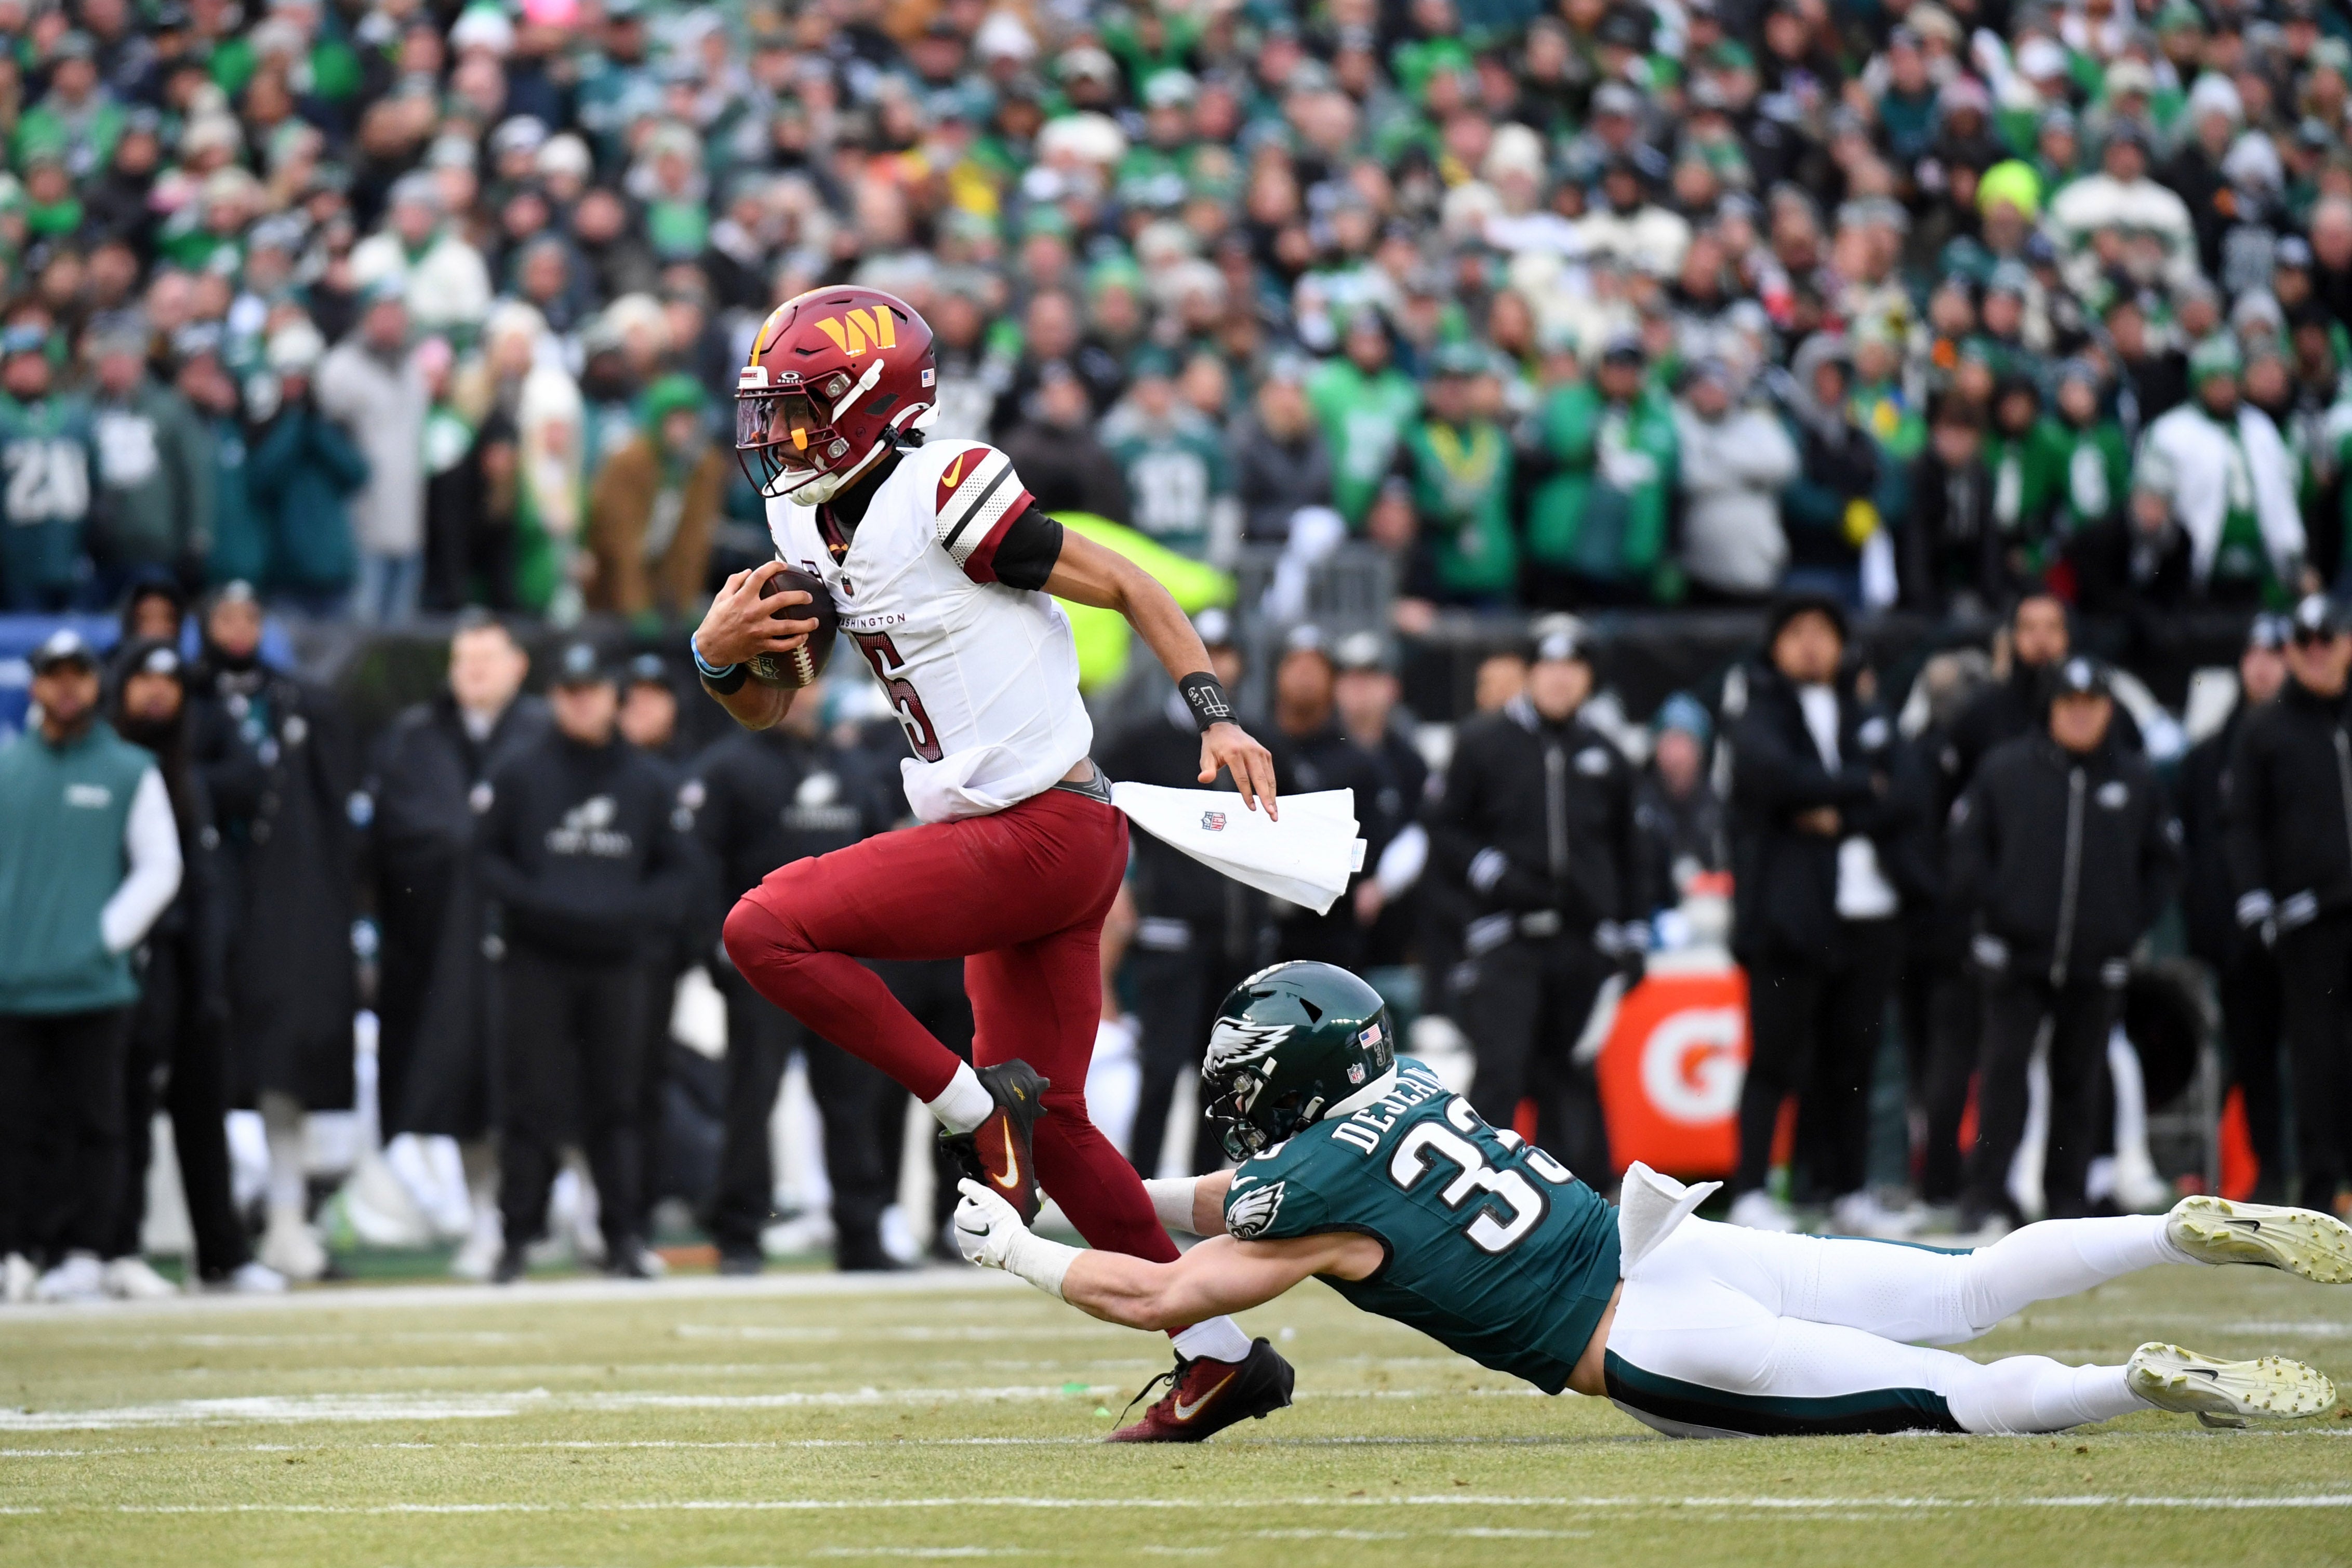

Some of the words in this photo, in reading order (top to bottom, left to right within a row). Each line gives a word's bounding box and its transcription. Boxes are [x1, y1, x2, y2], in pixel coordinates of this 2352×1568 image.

[814, 305, 896, 358] W
[838, 613, 905, 628] ASHINGTON
[850, 631, 944, 763] 5
[1639, 1005, 1747, 1127] G
